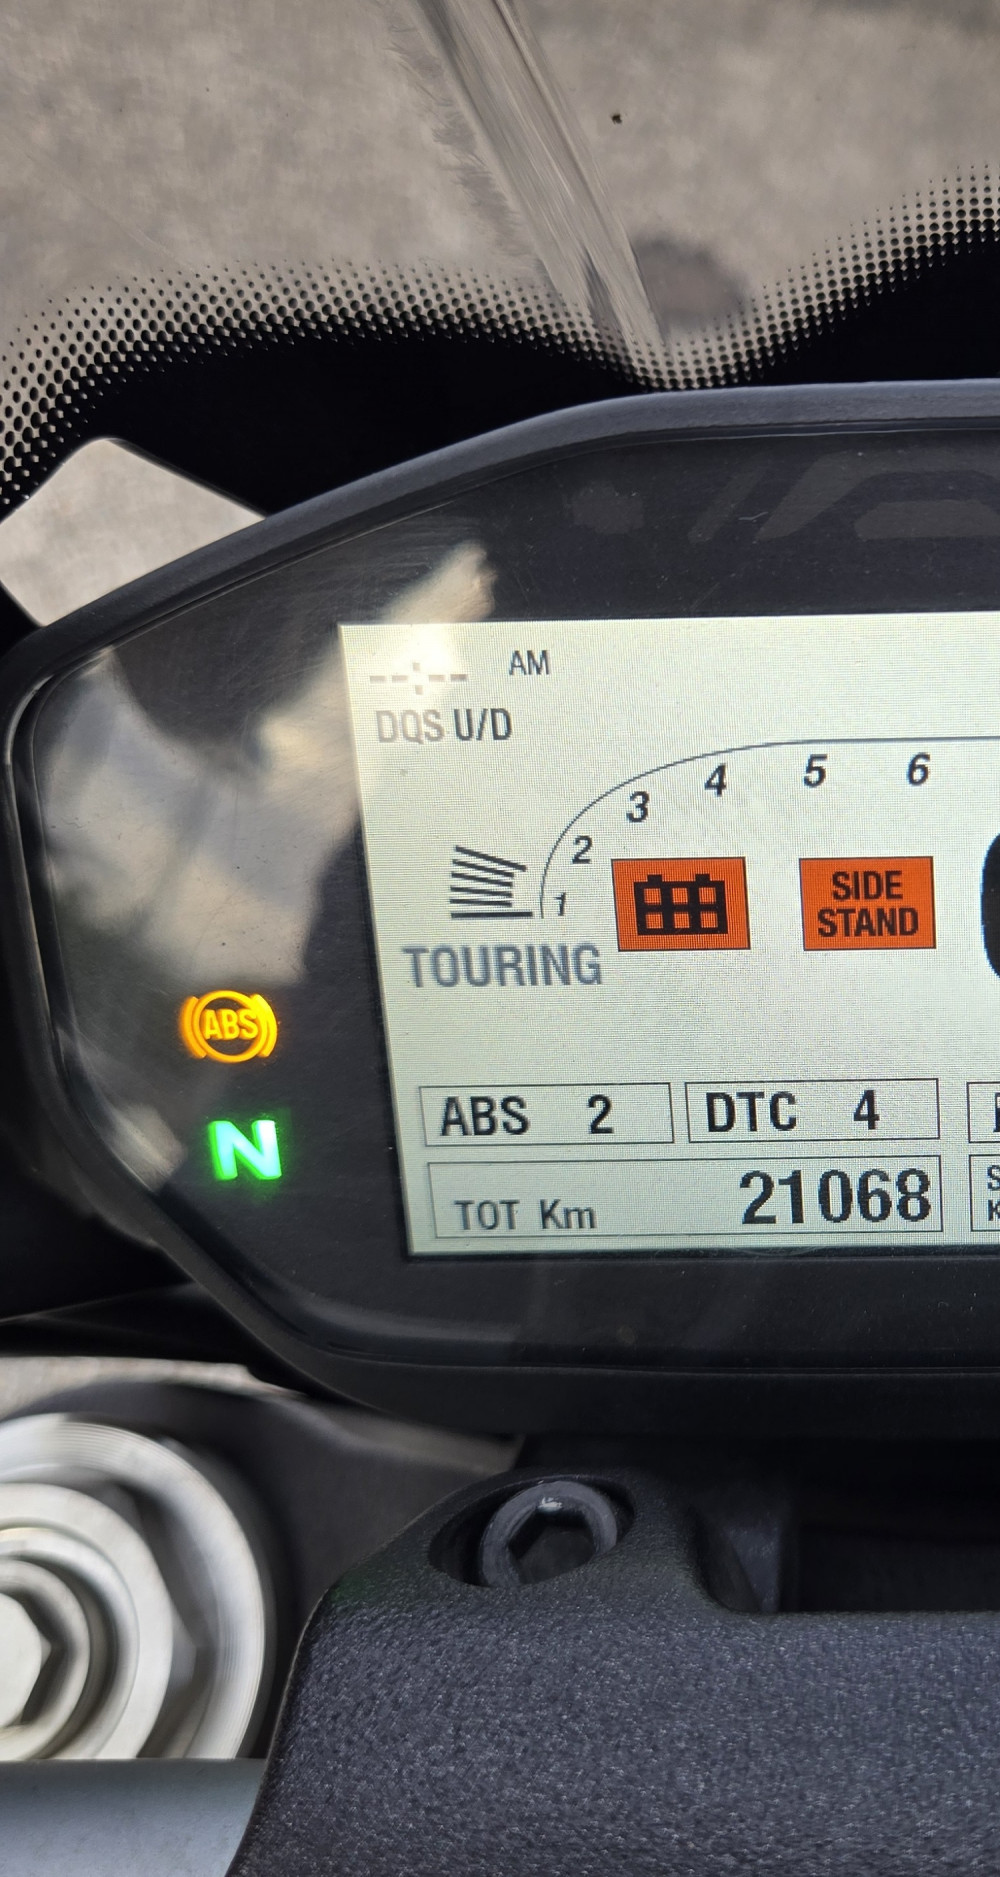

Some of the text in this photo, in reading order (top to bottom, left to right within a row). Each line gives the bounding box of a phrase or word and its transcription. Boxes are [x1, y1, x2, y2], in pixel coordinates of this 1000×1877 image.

[508, 649, 550, 677] AM
[375, 708, 513, 745] DQS U/D
[704, 763, 728, 797] 4
[803, 753, 829, 788] 5
[906, 753, 931, 786] 6
[626, 791, 650, 824] 3
[572, 834, 594, 865] 2
[831, 870, 904, 901] SIDE
[553, 892, 568, 917] 1
[817, 907, 919, 938] STAND
[402, 943, 602, 988] TOURING
[203, 1008, 259, 1040] ABS
[440, 1094, 614, 1136] ABS 2
[705, 1089, 880, 1132] DTC 4
[208, 1119, 282, 1181] N
[739, 1168, 931, 1226] 21068
[455, 1198, 598, 1230] TOT Km
